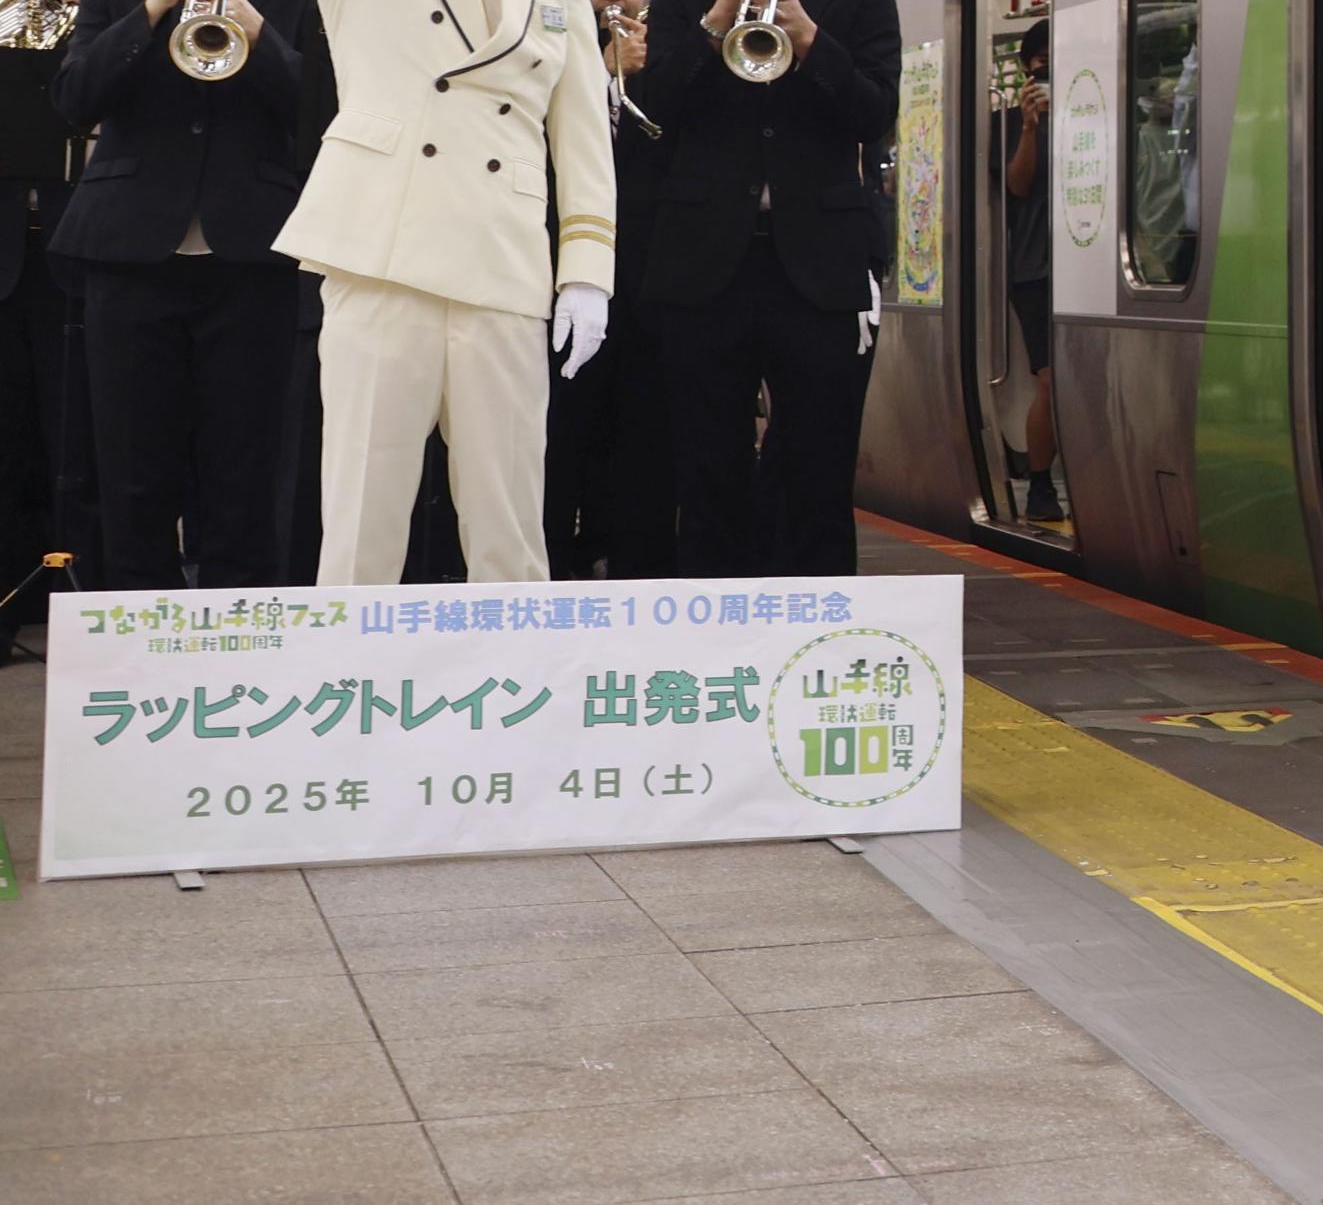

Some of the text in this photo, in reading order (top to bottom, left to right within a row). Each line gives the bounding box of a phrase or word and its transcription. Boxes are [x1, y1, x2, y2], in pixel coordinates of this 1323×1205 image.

[80, 596, 348, 634] つながる山手線フェス
[148, 634, 284, 653] 環状運転100周年
[803, 656, 912, 699] 山手線
[82, 665, 760, 746] ラッピングトレイン 出発式
[819, 703, 896, 723] 環状運転
[186, 779, 369, 817] 2025年
[417, 772, 513, 806] 10月
